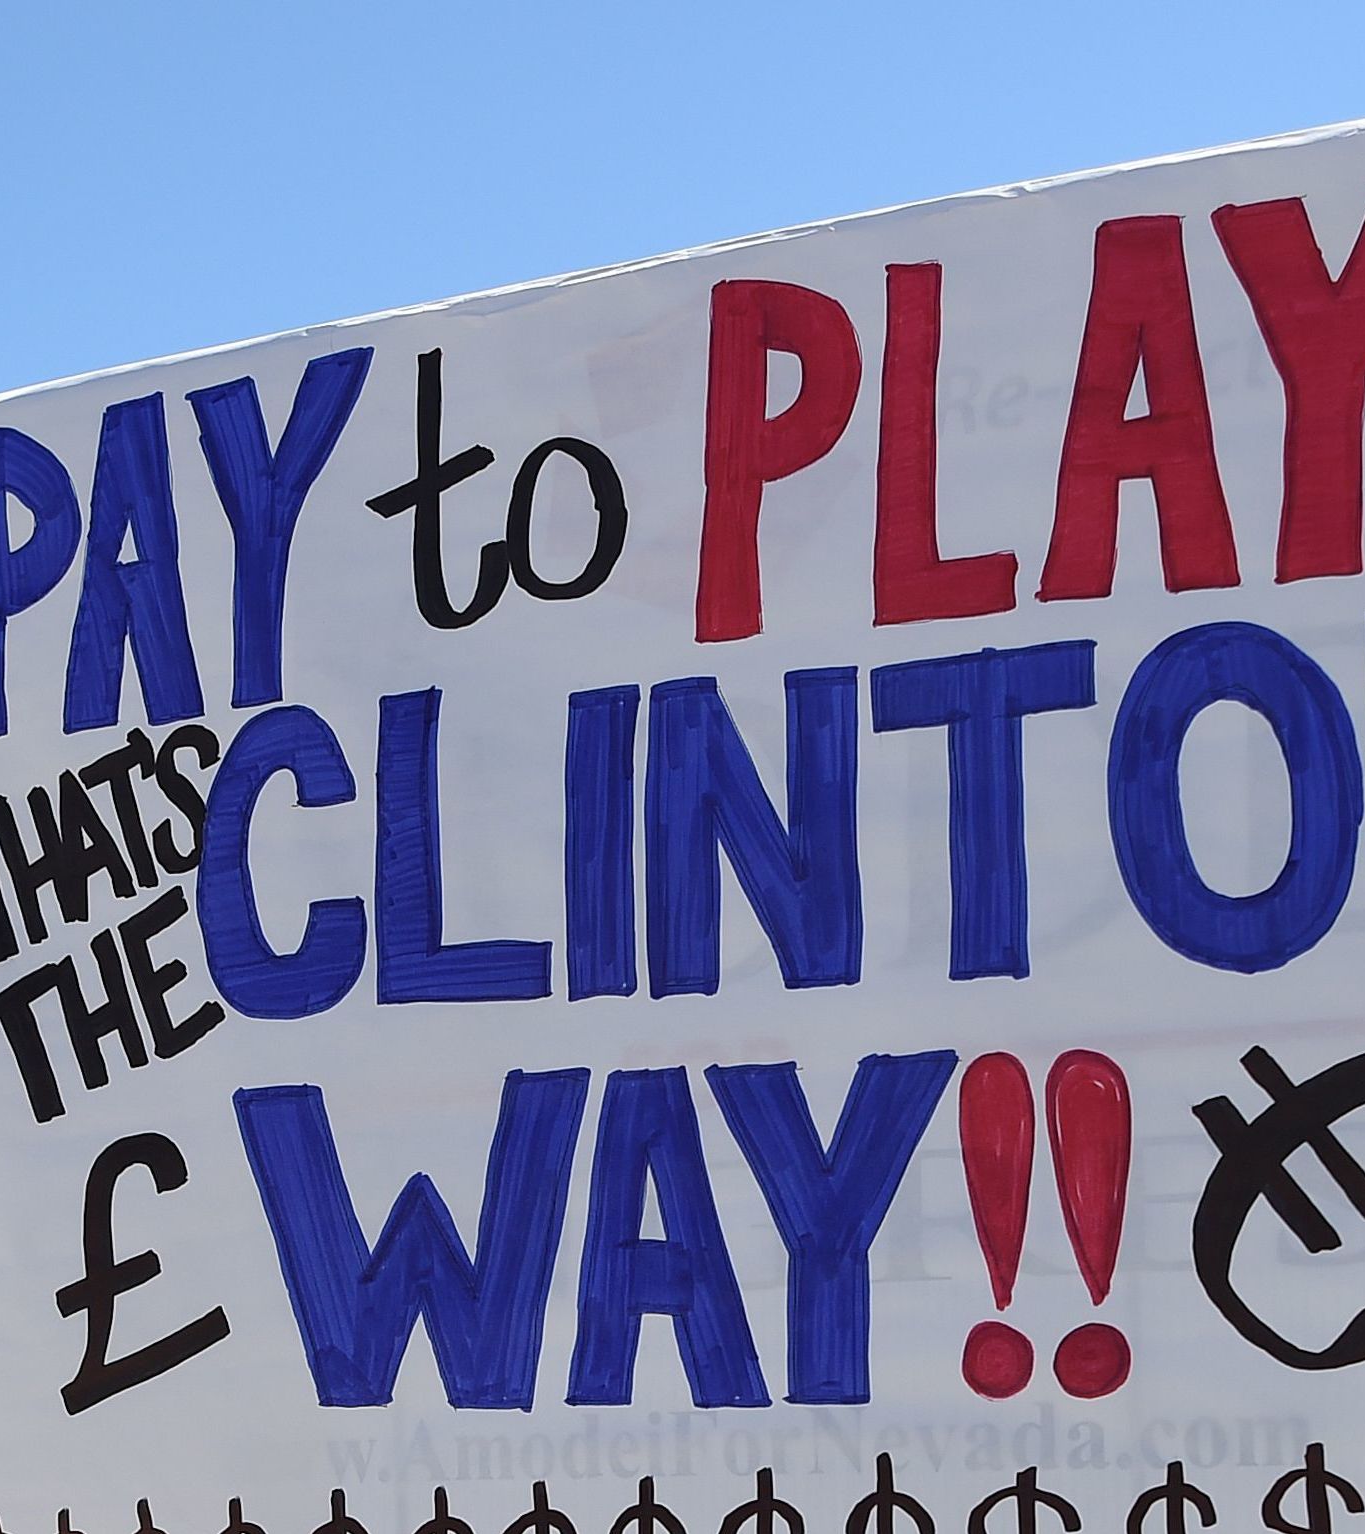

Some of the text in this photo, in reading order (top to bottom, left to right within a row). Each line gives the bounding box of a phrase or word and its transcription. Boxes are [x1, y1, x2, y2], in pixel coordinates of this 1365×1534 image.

[365, 348, 628, 630] to
[55, 1131, 229, 1415] £
[233, 1049, 1131, 1412] WAY!!
